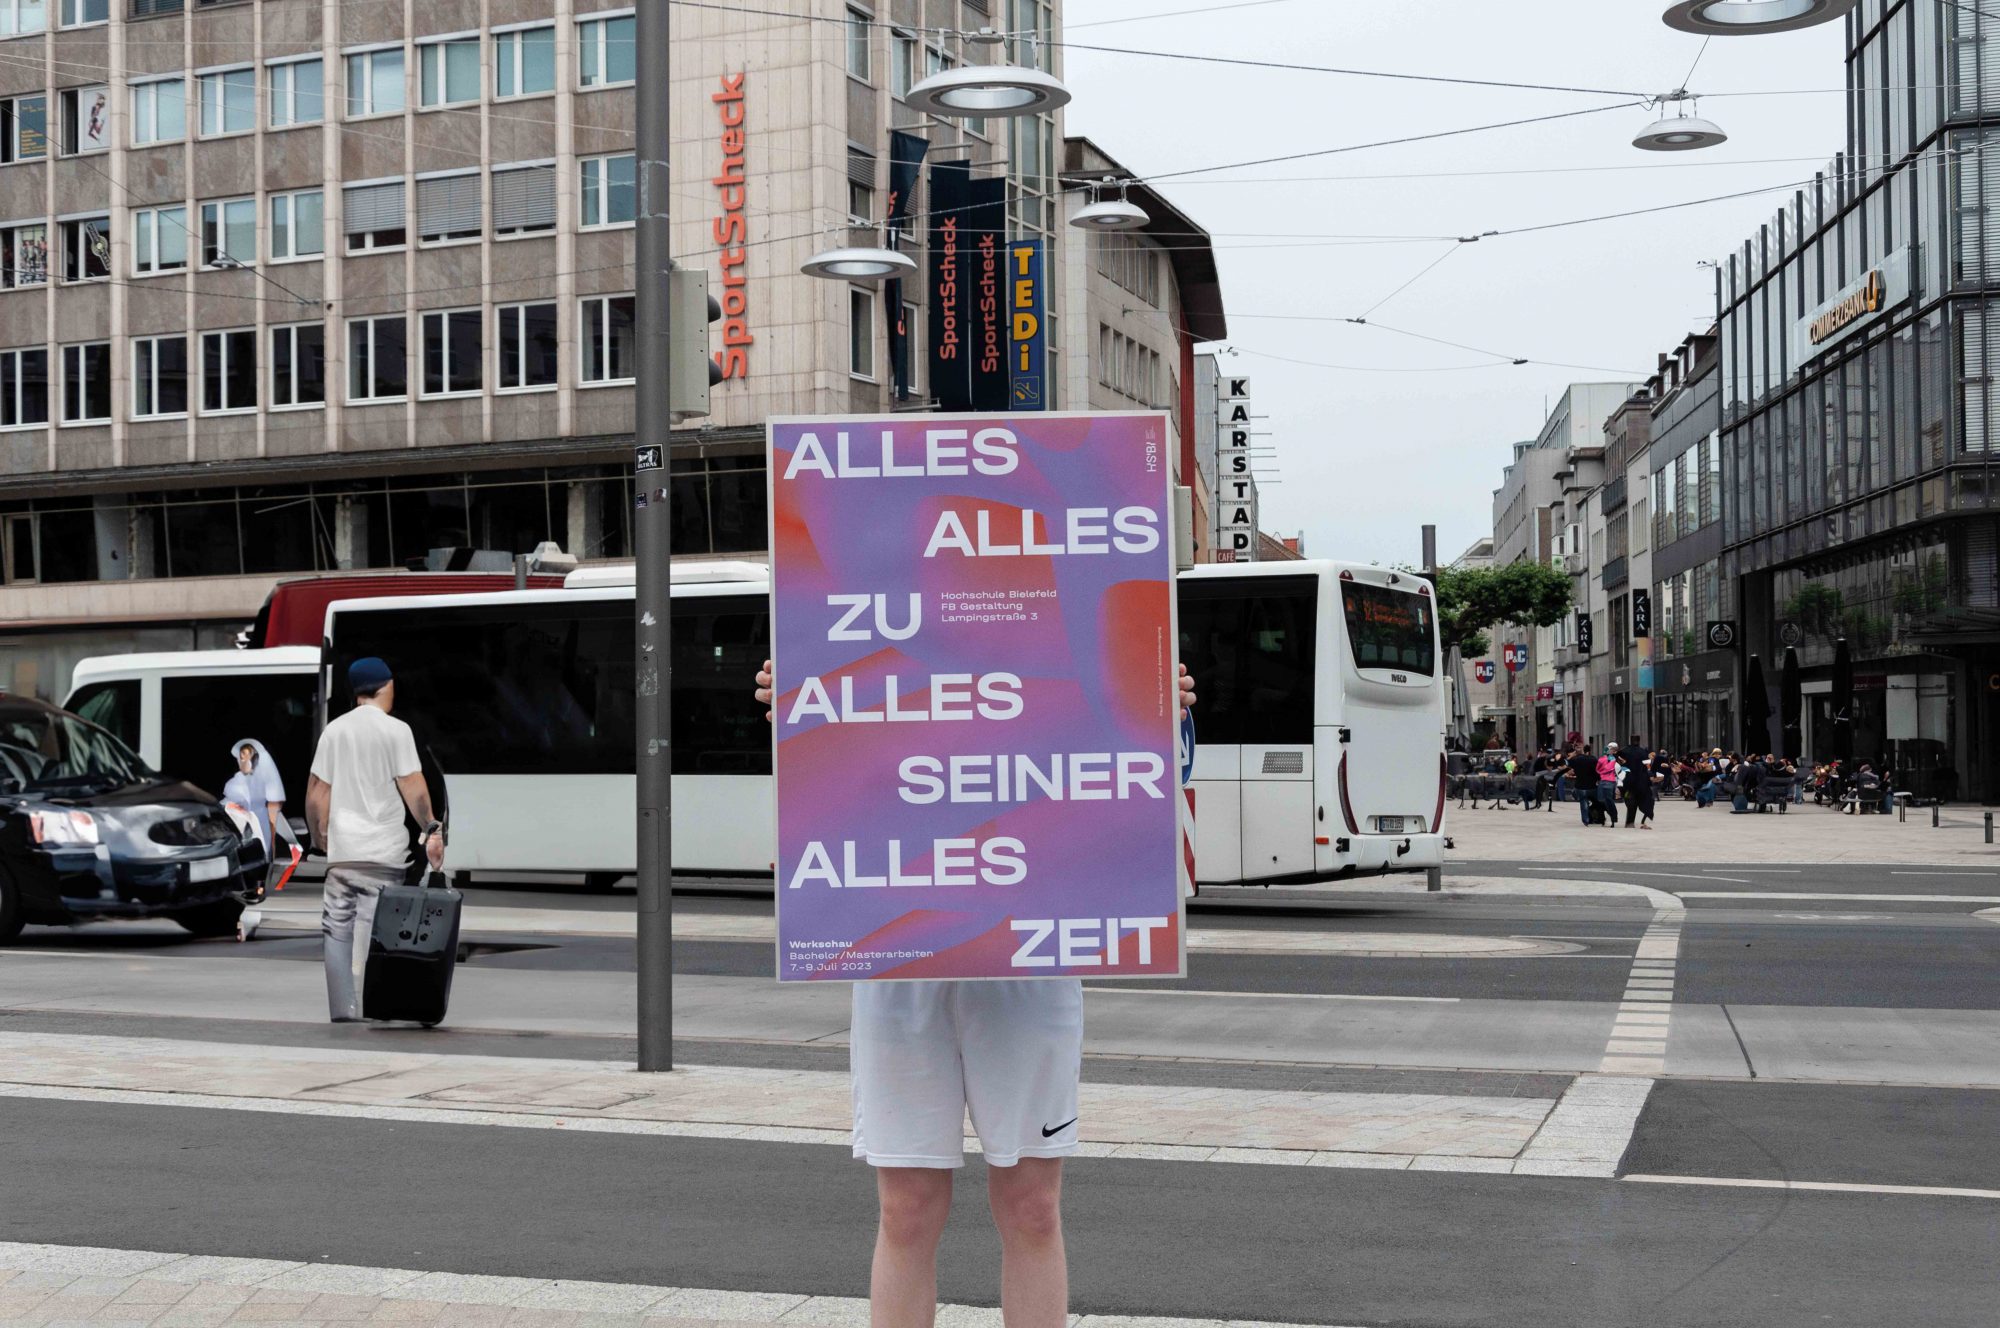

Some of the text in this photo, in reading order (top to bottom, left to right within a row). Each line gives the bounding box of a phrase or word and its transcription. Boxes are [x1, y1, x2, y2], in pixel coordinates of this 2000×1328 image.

[712, 72, 753, 379] SportScheck
[940, 216, 959, 360] SportScheck
[979, 233, 1000, 374] SportScheck
[1012, 246, 1039, 371] TEDi
[1810, 287, 1867, 345] COMMERZBANK
[784, 428, 1018, 480] ALLES
[1231, 379, 1250, 562] KARSTAD
[924, 506, 1159, 558] ALLES
[1217, 551, 1235, 563] CAFÉ
[828, 593, 921, 641] ZU
[941, 590, 1057, 600] Hochschule Bielefeld
[941, 602, 1023, 612] FB Gestaltung
[941, 612, 1038, 623] Lampingstraße 3
[1636, 596, 1646, 630] ZARA
[1505, 649, 1526, 663] P&C
[1580, 619, 1588, 648] ZARA
[1391, 673, 1407, 683] IVECO
[1476, 665, 1493, 677] P&C
[787, 672, 1023, 724] ALLES
[899, 752, 1165, 804] SEINER
[790, 837, 1027, 889] ALLES
[789, 940, 853, 949] Werkschau
[789, 949, 934, 960] Bachelor/Masterarbeiten
[1010, 917, 1168, 967] ZEIT
[841, 962, 872, 971] 2023
